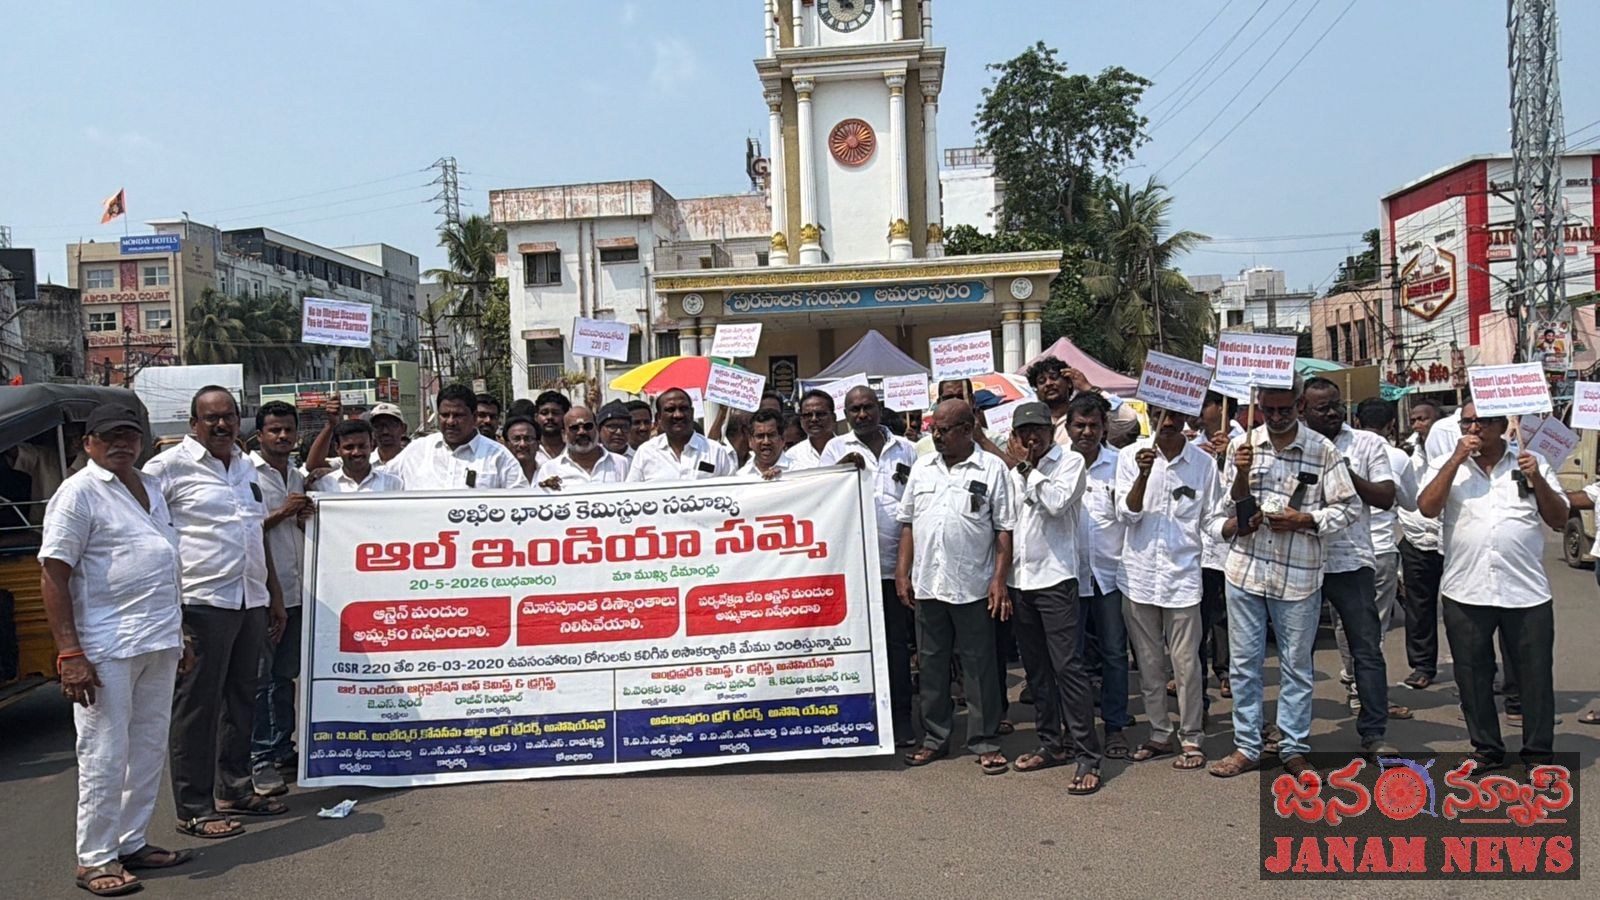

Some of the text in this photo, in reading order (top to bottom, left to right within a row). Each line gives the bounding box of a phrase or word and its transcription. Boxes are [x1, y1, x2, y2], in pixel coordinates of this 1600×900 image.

[152, 236, 177, 244] HOTELS
[111, 293, 136, 302] FOOD
[138, 291, 170, 300] COURT
[734, 283, 971, 312] పురపాలక సంఘం అమలాపురం
[322, 308, 340, 319] Illegal
[340, 309, 367, 321] Discounts
[323, 319, 341, 329] Ethical
[342, 321, 368, 333] Pharmacy
[121, 334, 171, 343] CNVENTION
[1220, 341, 1295, 357] Medicine is a Service
[1223, 355, 1236, 366] Not
[1236, 358, 1241, 366] a
[1242, 357, 1274, 368] Discount
[1275, 359, 1290, 370] War
[1145, 361, 1209, 387] Medicine is a Service
[1472, 375, 1495, 387] Support
[1495, 374, 1511, 386] Local
[1512, 373, 1541, 384] Chemists
[1145, 375, 1202, 399] Not a Discount War
[1474, 385, 1547, 400] Support Safe Healthcare
[447, 494, 741, 527] అఖిల భారత కెమిస్టుల సమాఖ్య
[355, 516, 828, 572] ఆల్ ఇండియా సమ్మె
[612, 564, 720, 583] మా ముఖ్య డిమాండ్లు
[409, 574, 557, 591] 20-5-2026 (బుధవారం)
[745, 590, 763, 604] లేని
[791, 586, 835, 599] మందుల
[411, 606, 469, 619] మందుల
[522, 600, 598, 616] మోసపూరిత
[560, 616, 644, 634] నిలిపివేయాలి.
[353, 629, 408, 646] అమ్మకం
[332, 662, 358, 676] (GSR
[362, 663, 391, 675] 220
[394, 659, 415, 673] తేది
[417, 658, 504, 672] 26-03-2020
[585, 650, 632, 664] రోగులకు
[634, 647, 669, 660] కలిగిన
[739, 639, 771, 654] మేము
[735, 665, 744, 674] &
[338, 684, 356, 694] ఆల్
[359, 685, 404, 695] ఇండియా
[515, 678, 525, 688] &
[650, 713, 710, 726] అమలాపురం
